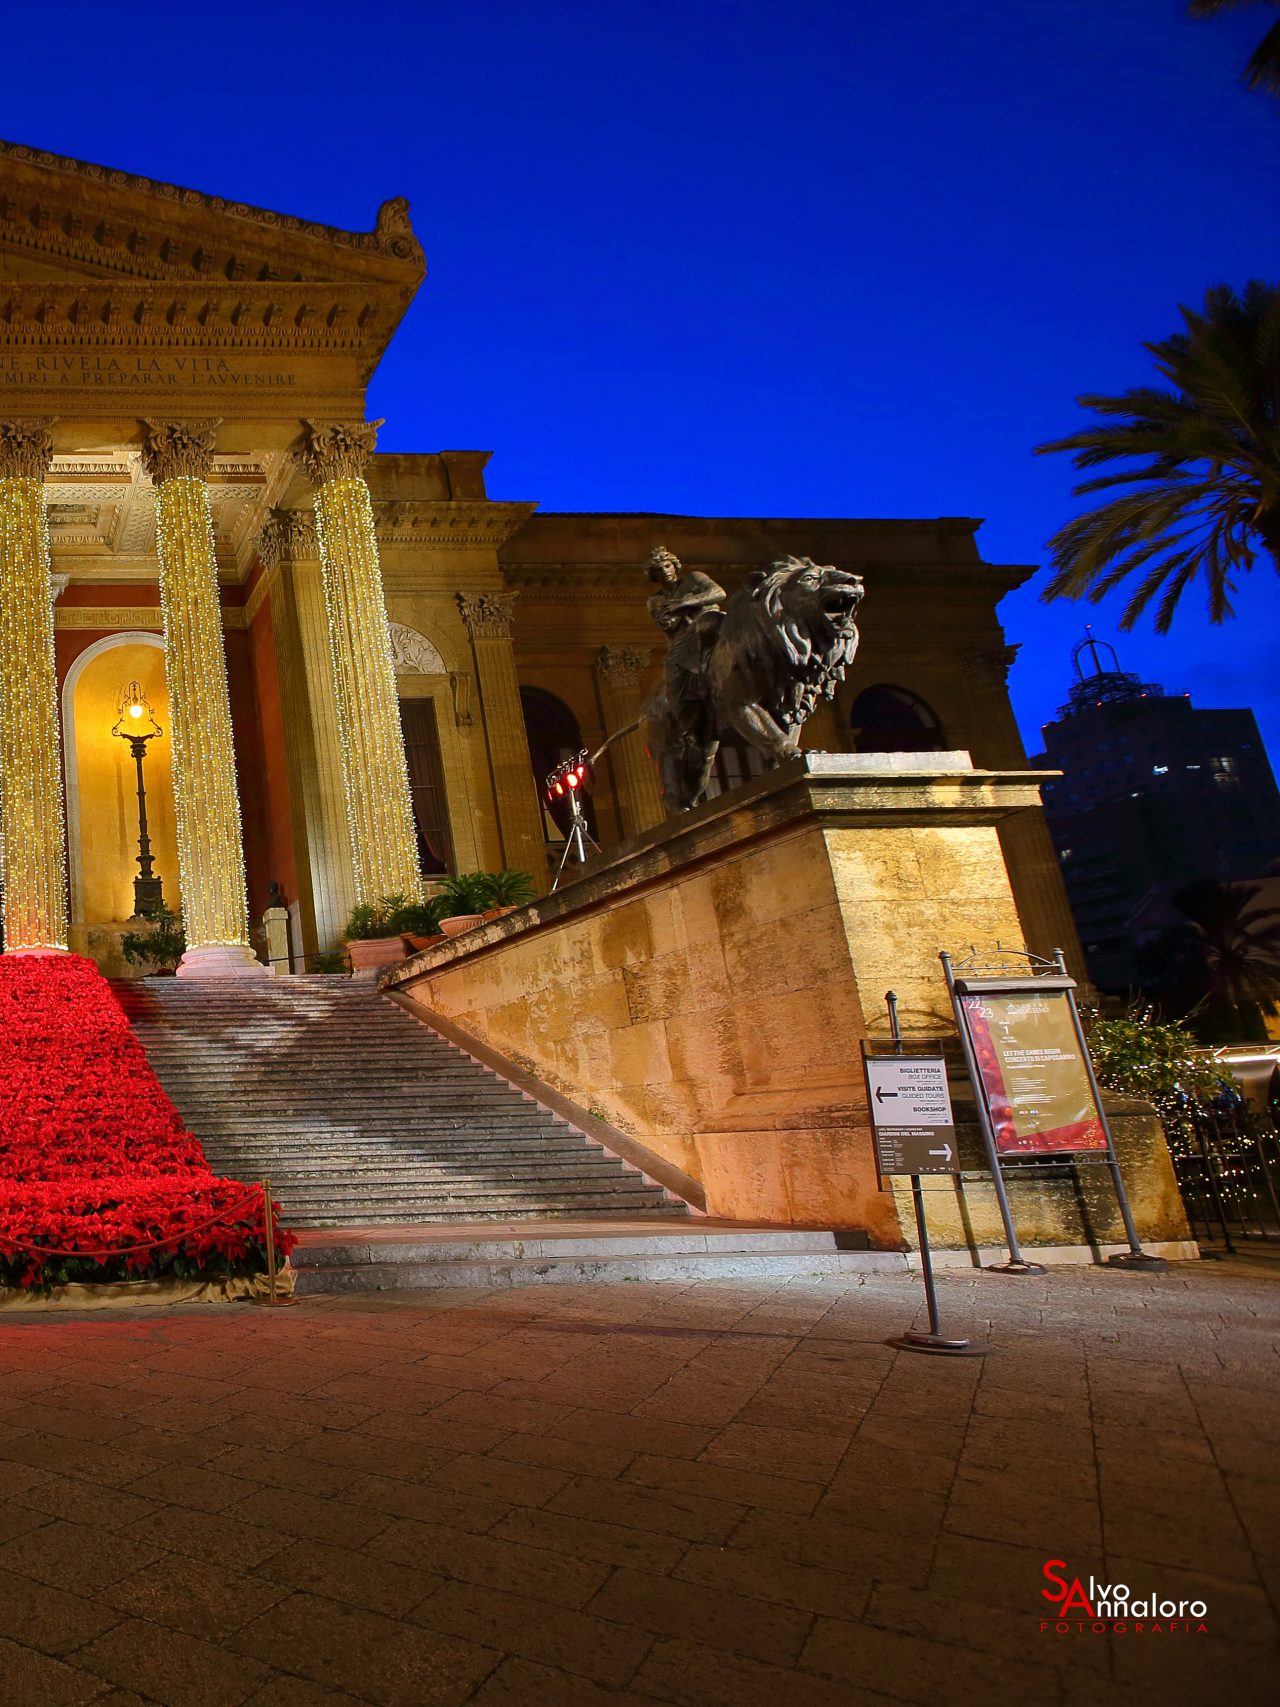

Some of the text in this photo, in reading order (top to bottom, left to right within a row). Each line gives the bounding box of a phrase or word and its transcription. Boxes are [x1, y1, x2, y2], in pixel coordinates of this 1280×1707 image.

[36, 357, 120, 371] RIVELA
[136, 357, 161, 371] LA
[174, 357, 231, 371] VITA
[5, 372, 48, 384] MIRI
[60, 373, 70, 384] A
[82, 373, 179, 384] PREPARAR
